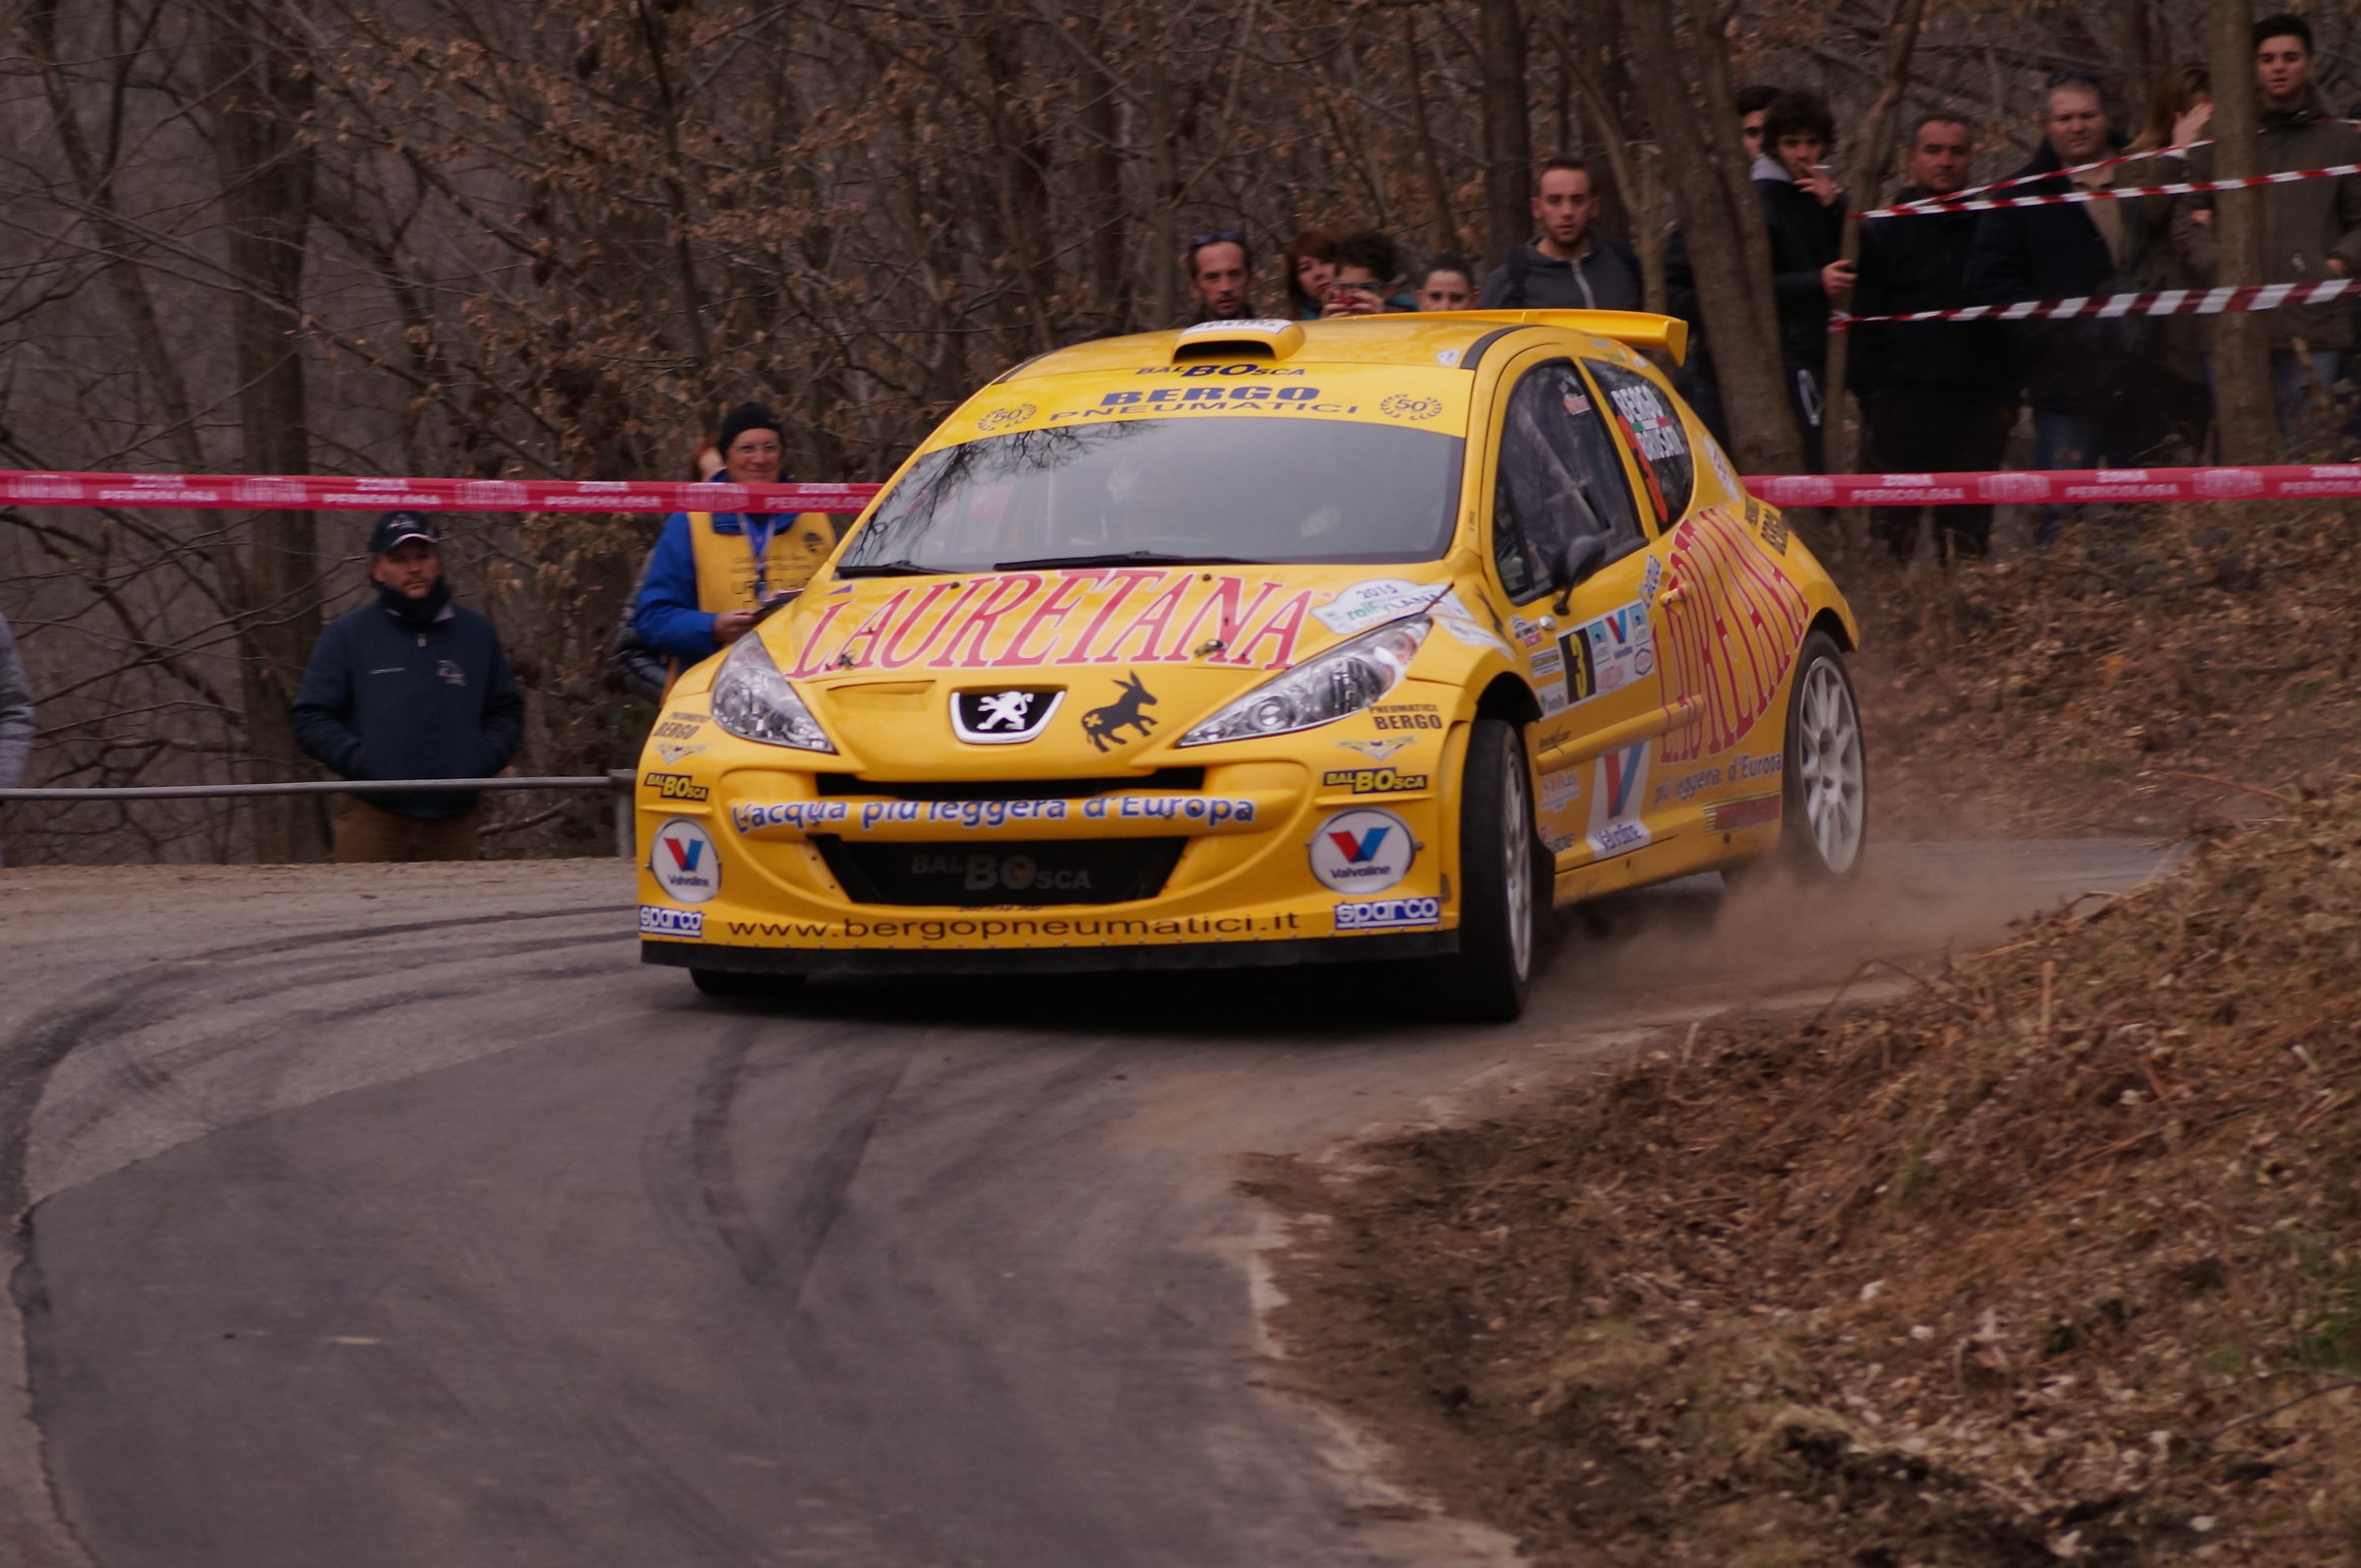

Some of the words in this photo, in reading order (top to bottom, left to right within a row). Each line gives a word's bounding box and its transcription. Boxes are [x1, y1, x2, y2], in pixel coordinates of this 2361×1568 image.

[1100, 387, 1320, 406] BERGO
[1394, 398, 1427, 412] 50
[994, 408, 1022, 422] 50
[1049, 402, 1359, 421] PNEUMATICI
[783, 568, 1314, 680] LAURETANA
[651, 721, 700, 740] BERGO
[1374, 714, 1443, 730] BERGO
[646, 774, 707, 800] BALBOSCA
[1326, 769, 1425, 793] BALBOSCA
[667, 874, 710, 887] Valvoline
[1331, 865, 1391, 878] Valvoline
[640, 906, 702, 931] sparco
[1337, 898, 1438, 925] sparco
[728, 911, 1299, 941] www.bergopneumatici.it
